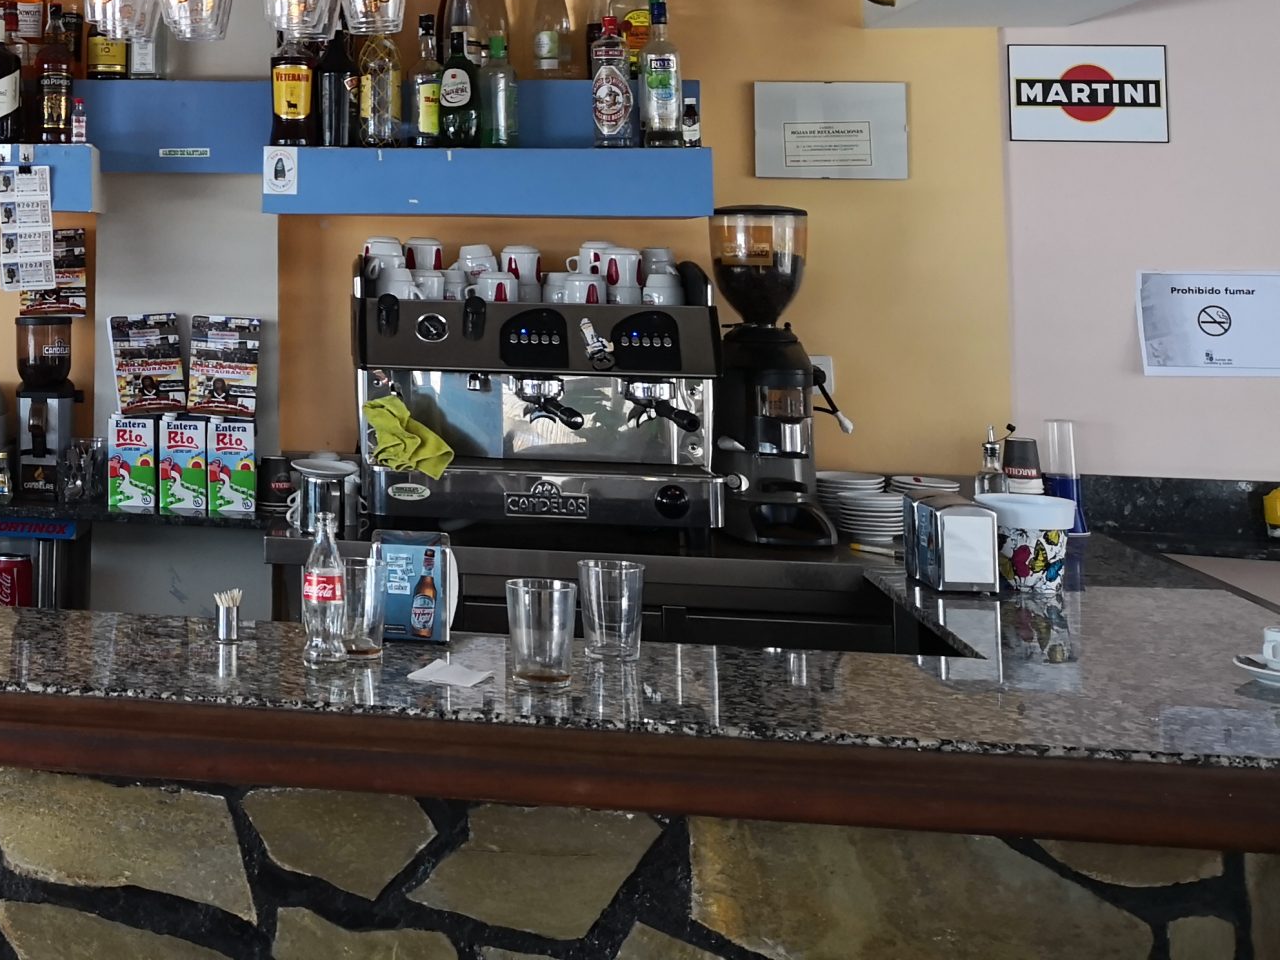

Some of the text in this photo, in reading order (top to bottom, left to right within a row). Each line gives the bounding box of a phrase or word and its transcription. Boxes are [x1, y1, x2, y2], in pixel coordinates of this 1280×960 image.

[651, 59, 674, 69] RIVES
[275, 71, 310, 82] VETERANO
[1020, 82, 1157, 104] MARTINI
[1170, 286, 1256, 296] Prohibido fumar
[122, 365, 177, 373] RESTAURANTE
[195, 368, 252, 376] RESTAURANTE
[115, 419, 147, 429] Entera
[166, 421, 199, 431] Entera
[215, 423, 247, 433] Entera
[116, 429, 143, 443] Rio
[167, 431, 194, 445] Rio
[216, 433, 243, 447] Rio
[507, 496, 587, 513] CANDELAS
